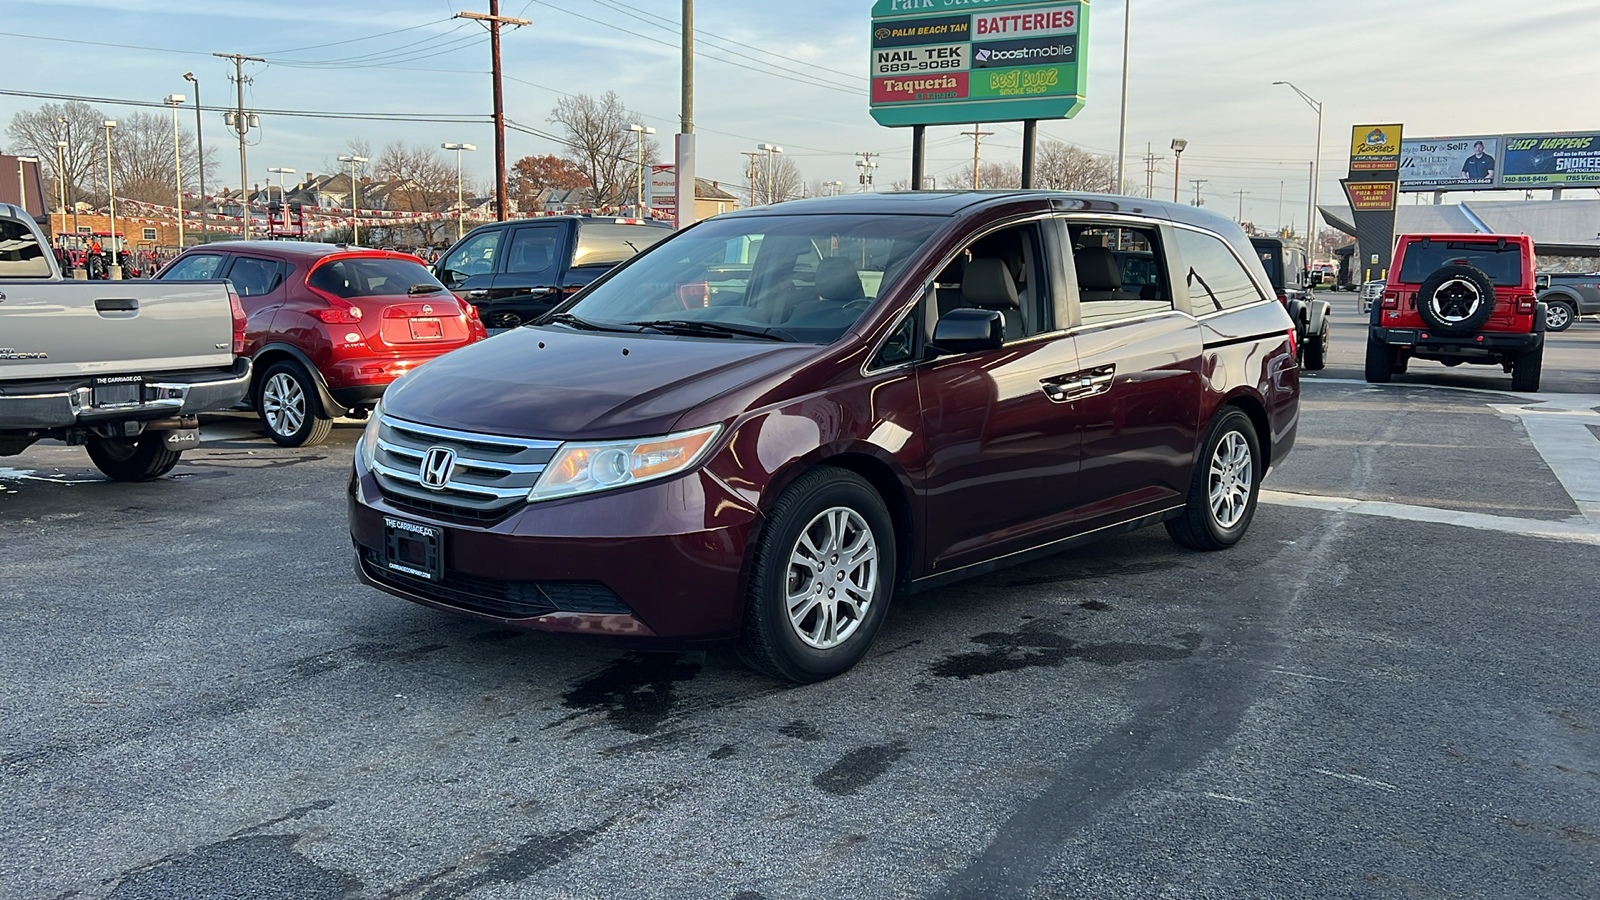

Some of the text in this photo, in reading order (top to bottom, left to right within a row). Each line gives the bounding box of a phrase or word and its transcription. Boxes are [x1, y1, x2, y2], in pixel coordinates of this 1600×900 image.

[977, 10, 1074, 34] BATTERIES
[892, 23, 968, 37] PALM BEACH TAN
[878, 46, 962, 63] NAIL TEK
[992, 45, 1074, 60] boostmobile
[880, 59, 961, 73] 689-9088
[884, 75, 957, 94] Taquería
[1022, 68, 1058, 87] BUDZ
[1357, 142, 1395, 154] Roosters
[1420, 144, 1437, 153] Buy
[1447, 143, 1469, 151] Sell?
[1539, 137, 1594, 150] HAPPENS
[168, 432, 195, 443] 4x4
[384, 518, 397, 528] THE
[396, 521, 424, 535] CARRIAGE
